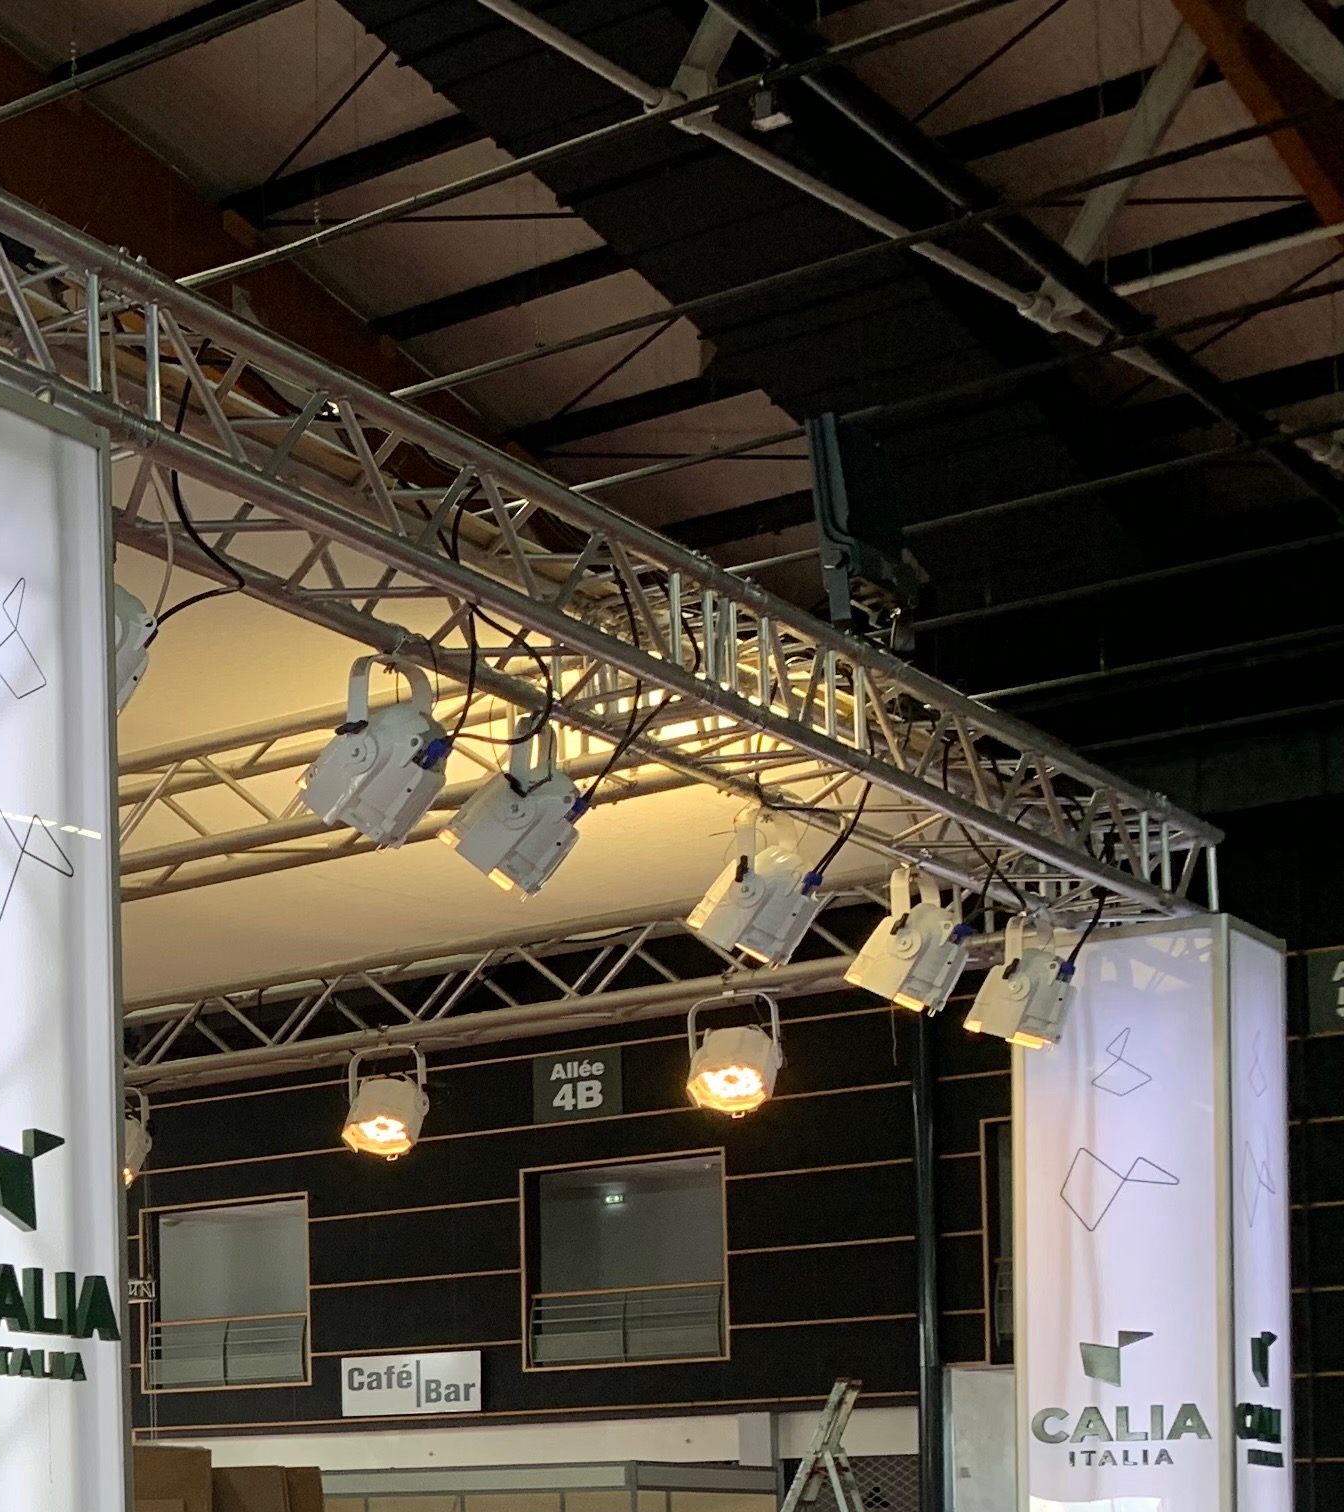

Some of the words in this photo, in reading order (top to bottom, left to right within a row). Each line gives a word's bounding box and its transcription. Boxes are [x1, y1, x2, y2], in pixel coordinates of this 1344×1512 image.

[550, 1059, 605, 1081] Allée
[552, 1080, 604, 1112] 4B
[347, 1363, 412, 1391] Café
[425, 1379, 475, 1403] Bar
[1031, 1403, 1213, 1444] CALIA
[1069, 1448, 1174, 1467] ITALIA
